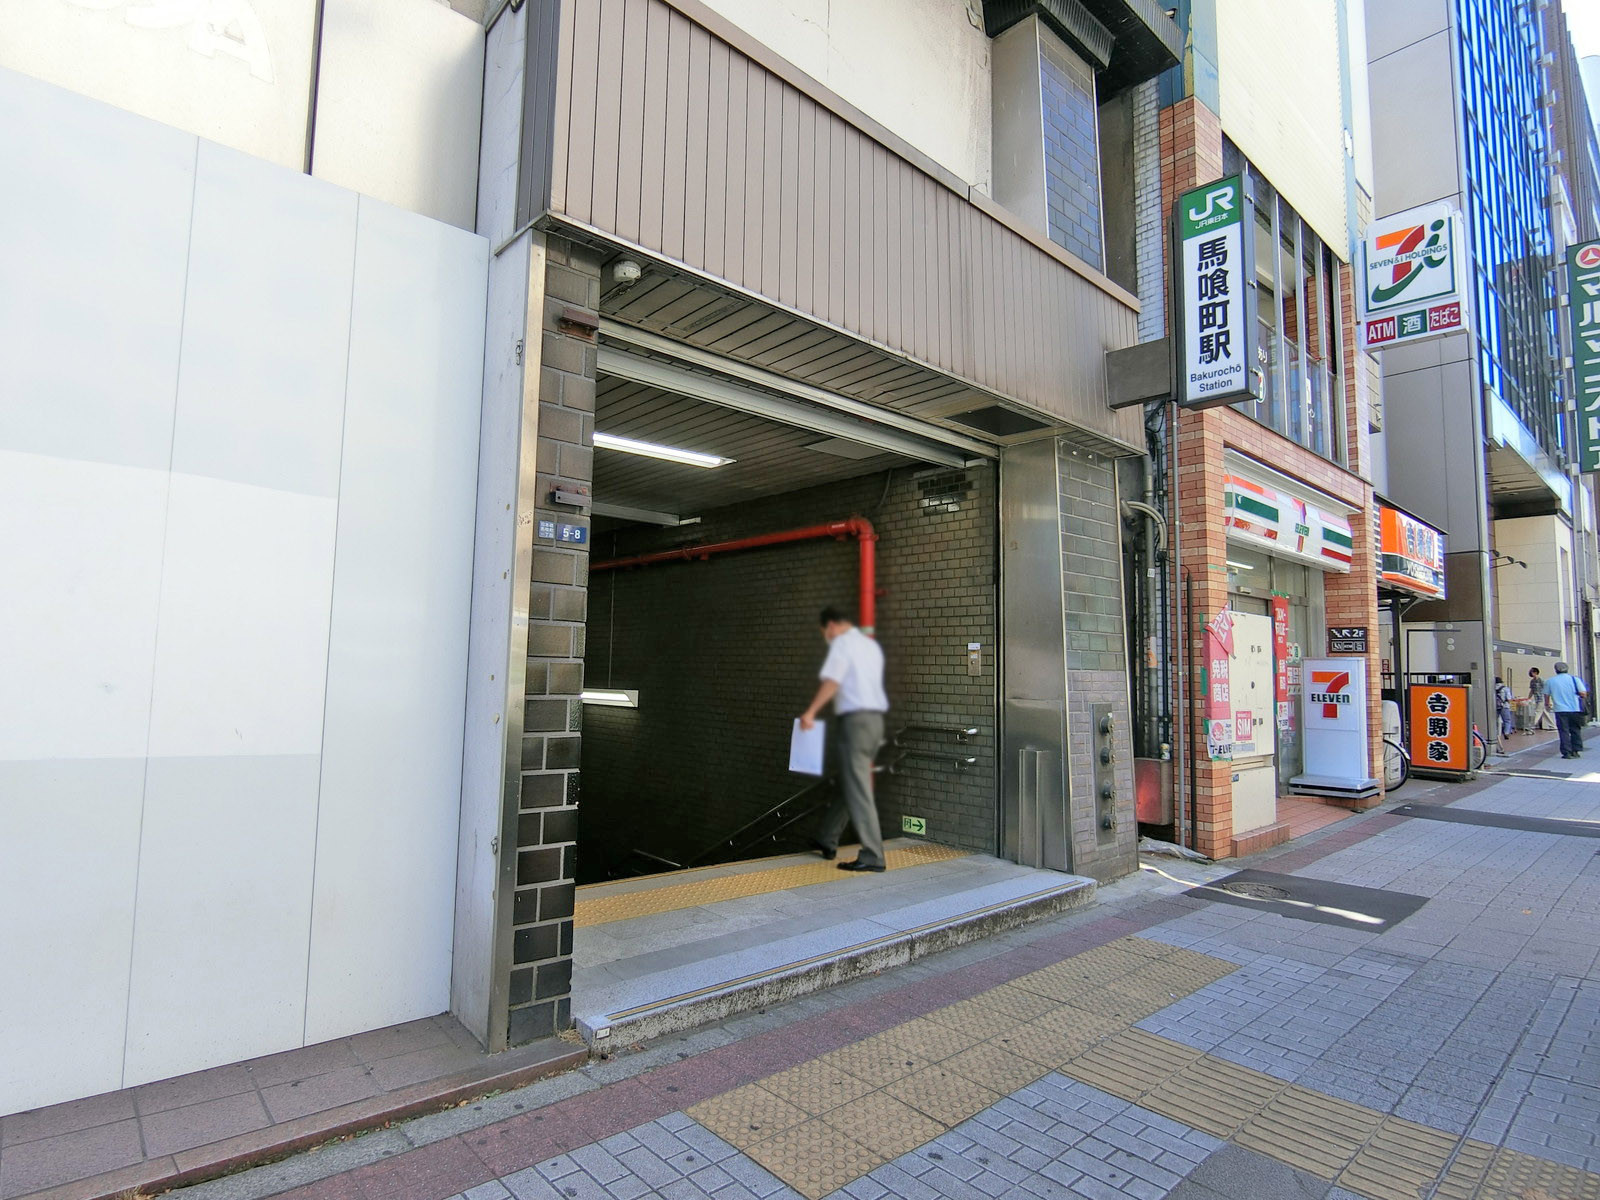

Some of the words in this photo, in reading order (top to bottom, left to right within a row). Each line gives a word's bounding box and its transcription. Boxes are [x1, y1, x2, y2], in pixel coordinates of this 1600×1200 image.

[1189, 186, 1234, 222] JR
[1405, 243, 1448, 262] HOLDINGS
[1197, 235, 1232, 365] 馬喰町駅
[1403, 313, 1421, 334] 酒
[1430, 306, 1459, 327] たばこ
[1368, 320, 1394, 341] ATM
[1199, 379, 1233, 392] Station
[562, 528, 581, 539] 5-8
[1352, 629, 1365, 637] 2F
[1426, 692, 1450, 762] 吉野家
